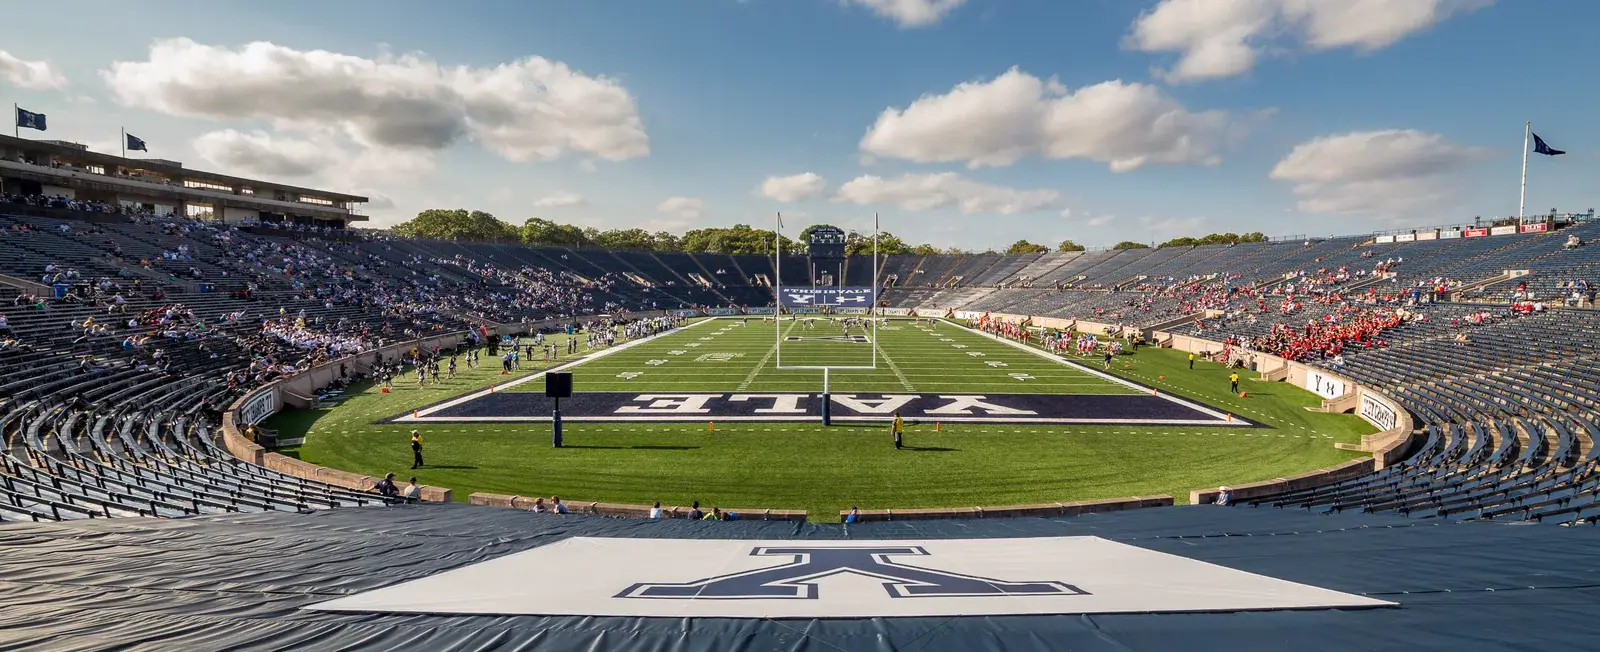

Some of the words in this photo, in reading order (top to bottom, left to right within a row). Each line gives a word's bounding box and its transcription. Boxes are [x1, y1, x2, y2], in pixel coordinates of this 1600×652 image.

[1315, 374, 1322, 392] Y
[613, 394, 1038, 415] YALE
[611, 546, 1094, 600] Y
